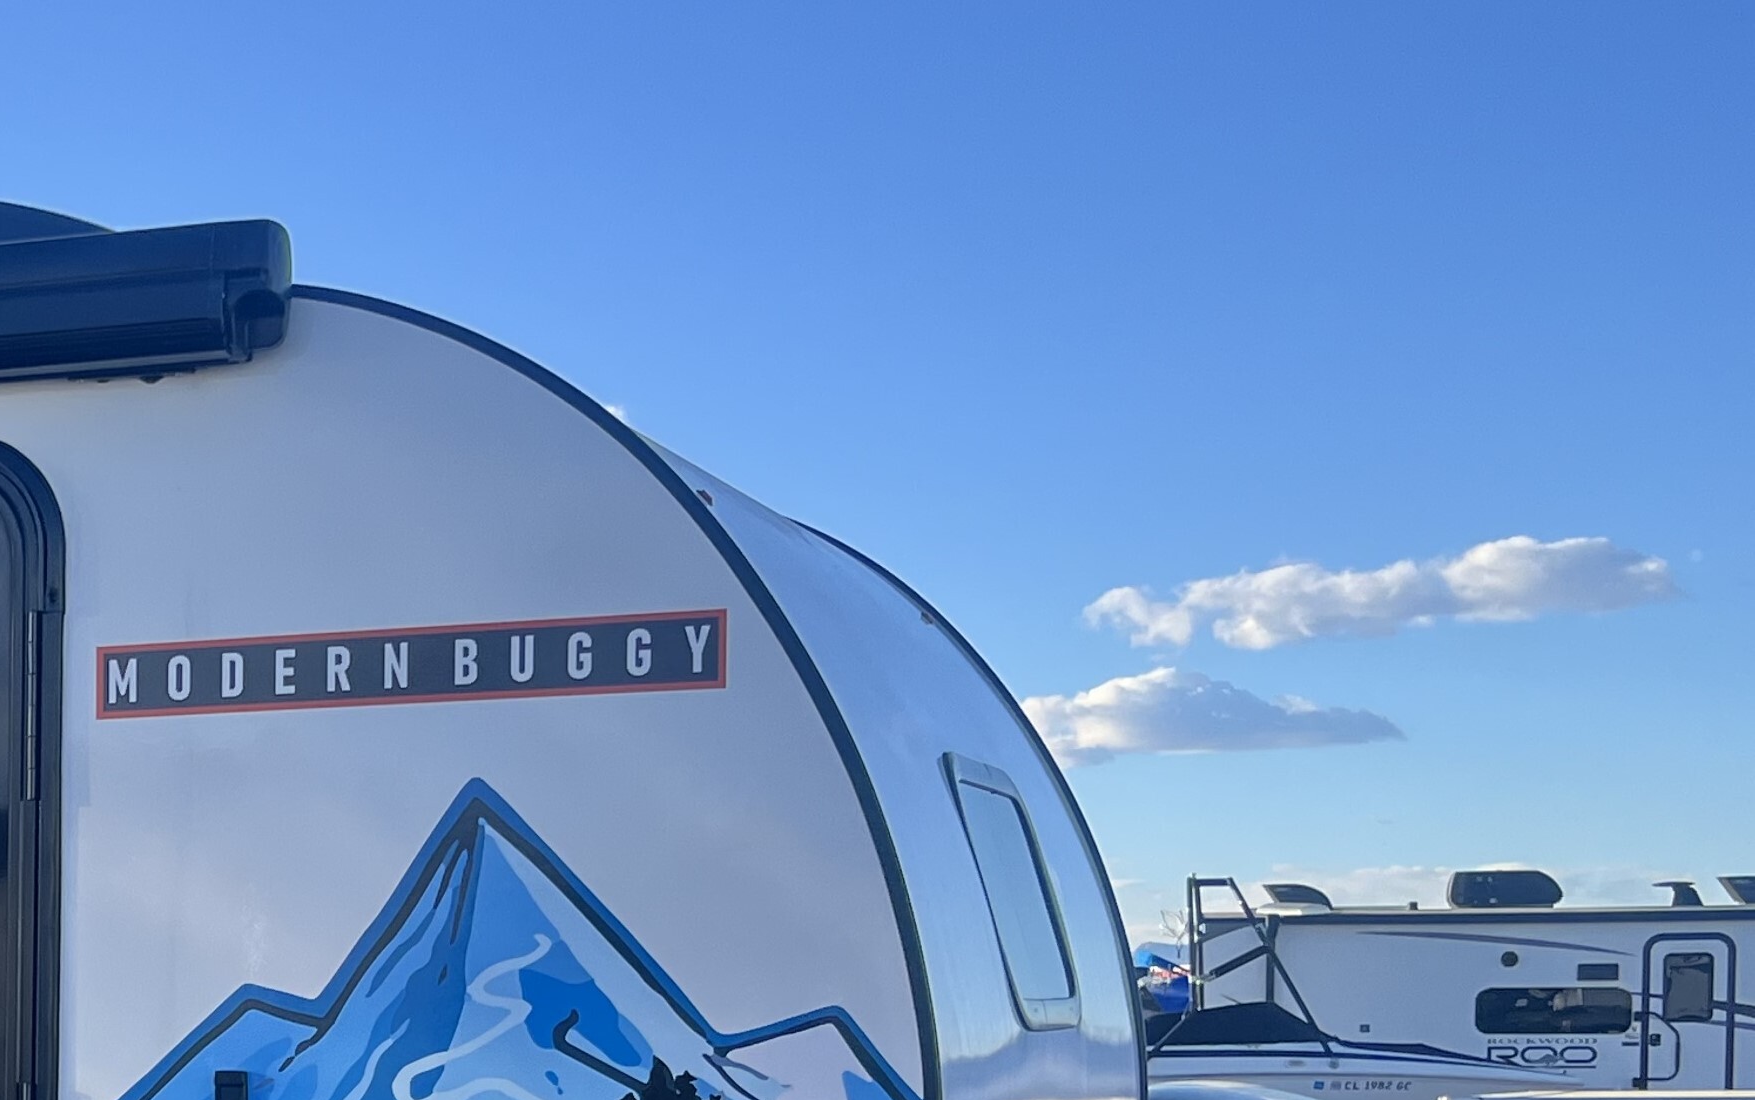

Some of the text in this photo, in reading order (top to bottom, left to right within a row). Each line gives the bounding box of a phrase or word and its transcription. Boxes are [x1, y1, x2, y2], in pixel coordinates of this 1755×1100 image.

[107, 624, 712, 704] MODERN BUGGY
[1344, 1081, 1360, 1091] CL
